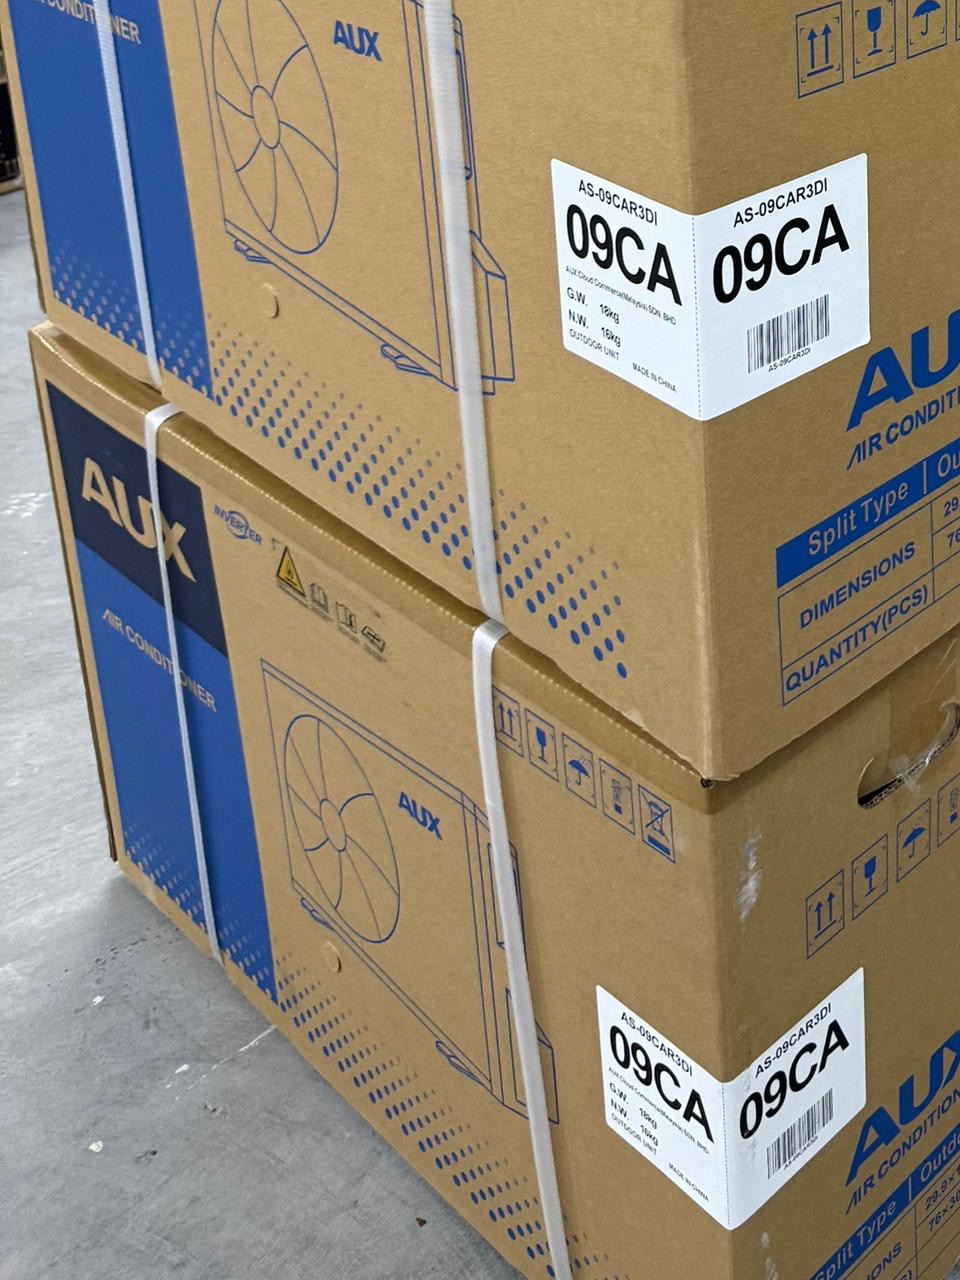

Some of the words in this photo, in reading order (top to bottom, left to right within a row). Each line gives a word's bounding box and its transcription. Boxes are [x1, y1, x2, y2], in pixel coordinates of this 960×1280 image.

[333, 20, 382, 61] AUX
[579, 179, 657, 226] AS-09CAR3DI
[733, 177, 828, 228] AS-09CAR3DI
[567, 204, 682, 306] 09CA
[713, 203, 850, 304] 09CA
[567, 287, 588, 307] G.W.
[600, 304, 620, 325] 18kg
[568, 309, 589, 329] N.W.
[601, 327, 621, 348] 16kg
[569, 328, 602, 352] OUTDOOR
[603, 346, 620, 360] UNIT
[768, 347, 811, 373] AS-09CAR3DI
[632, 362, 650, 378] MADE
[847, 432, 882, 470] AIR
[81, 456, 197, 583] AUX
[213, 503, 263, 546] INVERTER
[808, 512, 857, 555] Split
[860, 480, 908, 526] Type
[800, 541, 916, 629] DIMENSIONS
[102, 608, 124, 633] AIR
[125, 624, 217, 713] CONDITONER
[785, 583, 929, 692] QUANTITY(PCS)
[398, 791, 443, 842] AUX
[621, 1012, 693, 1076] AS-09CAR3DI
[755, 1002, 832, 1078] AS-09CAR3DI
[610, 1025, 714, 1144] 09CA
[740, 1019, 850, 1139] 09CA
[846, 1175, 876, 1216] AIR
[857, 1201, 896, 1246] Type
